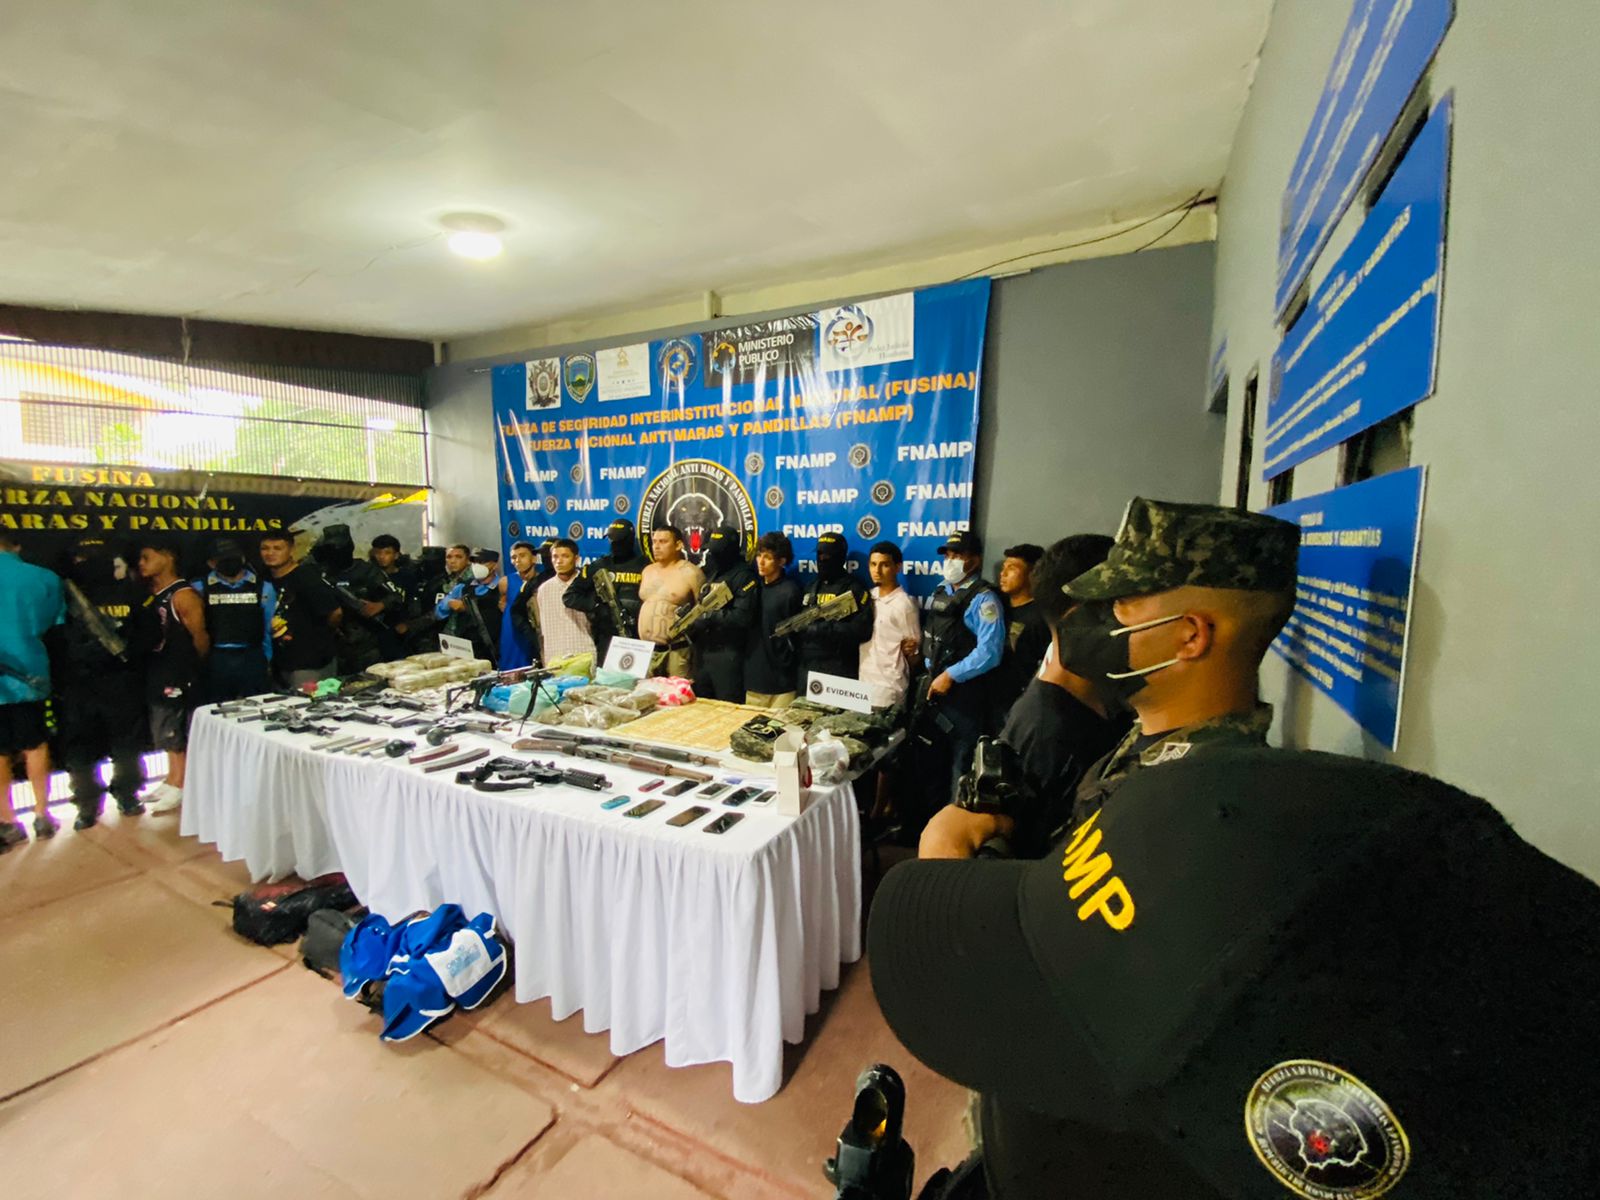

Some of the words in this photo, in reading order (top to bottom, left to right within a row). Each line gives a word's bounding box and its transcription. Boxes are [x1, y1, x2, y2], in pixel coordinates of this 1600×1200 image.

[738, 333, 794, 352] MINISTERIO
[739, 349, 779, 365] PÚBLICO
[541, 421, 557, 433] DE
[559, 414, 627, 431] SEGURIDAD
[885, 370, 977, 400] (FUSINA)
[575, 433, 635, 449] NCIONAL
[640, 430, 673, 444] ANTI
[674, 425, 724, 441] MARAS
[728, 423, 739, 437] Y
[743, 415, 831, 435] PANDILLAS
[836, 403, 914, 429] (FNAMP)
[897, 441, 973, 462] FNAMP
[680, 463, 699, 474] ANTI
[775, 452, 837, 470] FNAMP
[32, 466, 155, 487] FUSINA
[600, 466, 647, 480] FNAMP
[0, 488, 73, 506] RZA
[84, 491, 235, 510] NACIONAL
[566, 498, 609, 511] FNAMP
[797, 488, 859, 505] FNAMP
[99, 515, 118, 529] Y
[130, 516, 282, 531] PANDILLAS
[902, 560, 944, 575] FNA
[826, 687, 869, 700] EVIDENCIA
